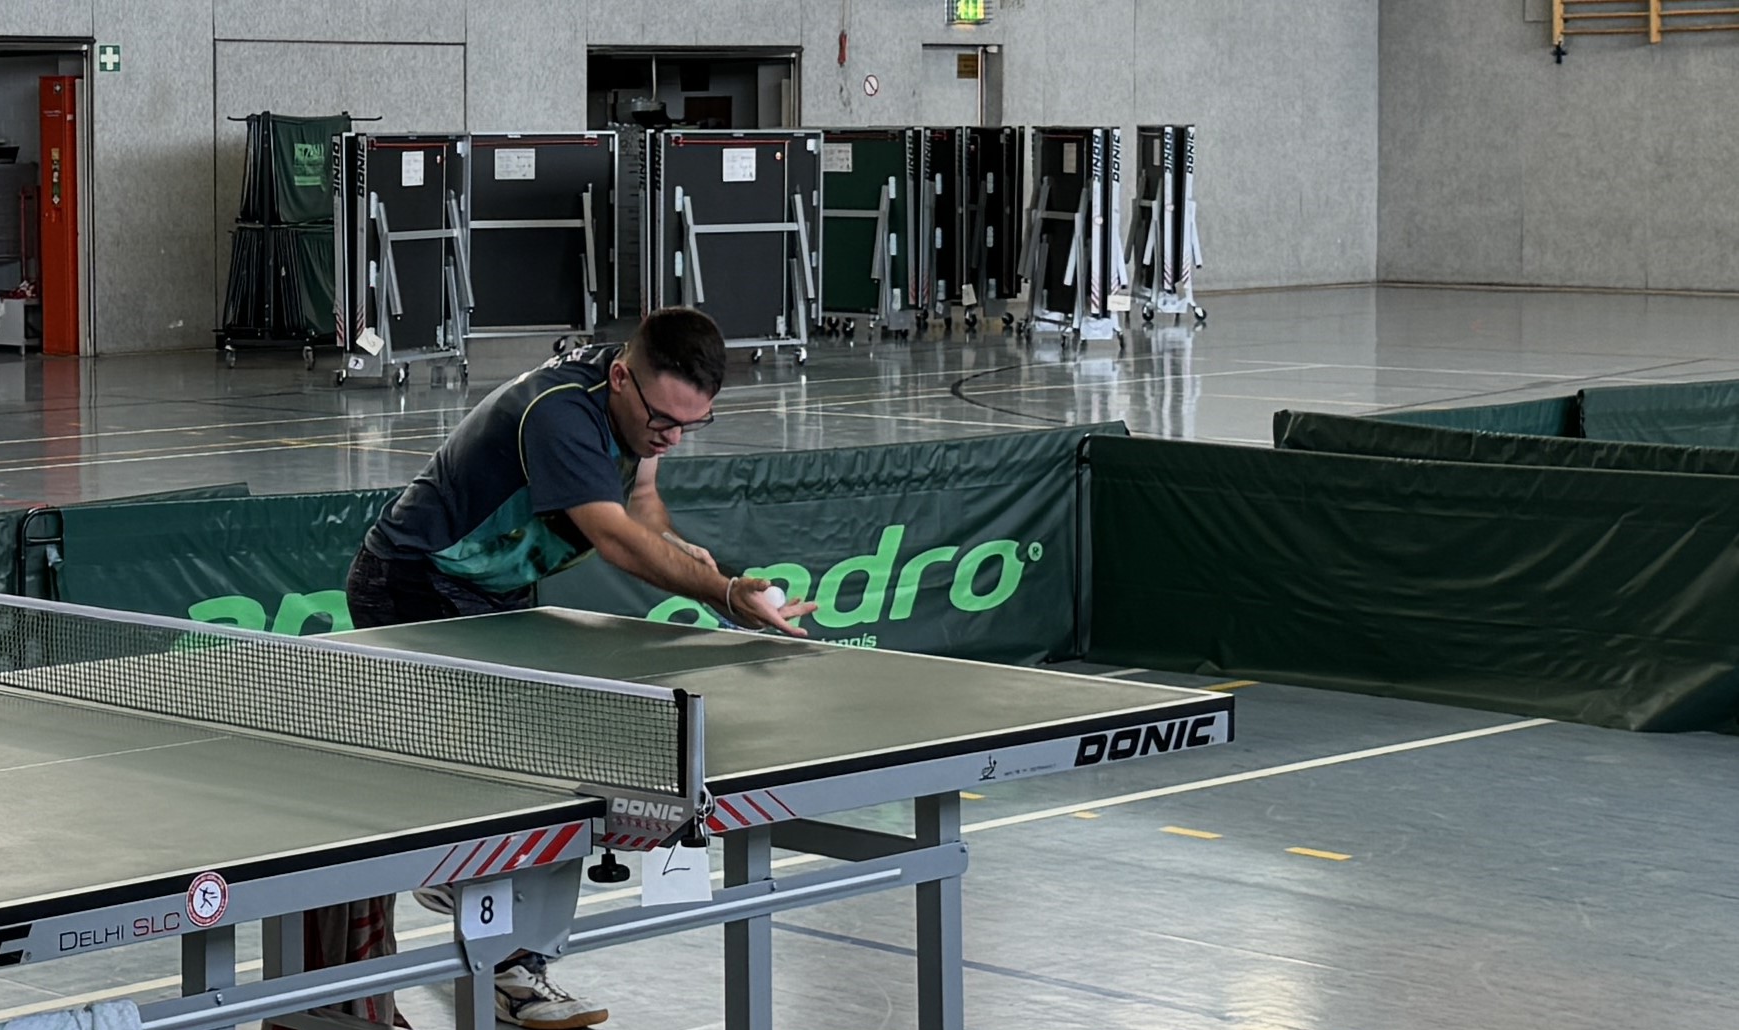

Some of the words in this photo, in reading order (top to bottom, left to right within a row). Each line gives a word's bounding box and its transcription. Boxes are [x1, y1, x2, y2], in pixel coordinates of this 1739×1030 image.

[332, 141, 341, 197] DONIC
[357, 140, 366, 198] DONIC
[1111, 133, 1121, 183] DONIC
[1074, 716, 1216, 767] DONIC
[611, 797, 684, 821] DONIC
[614, 814, 672, 833] STRESS
[59, 925, 124, 951] DELHI
[133, 912, 180, 937] SLC
[479, 895, 494, 925] 8
